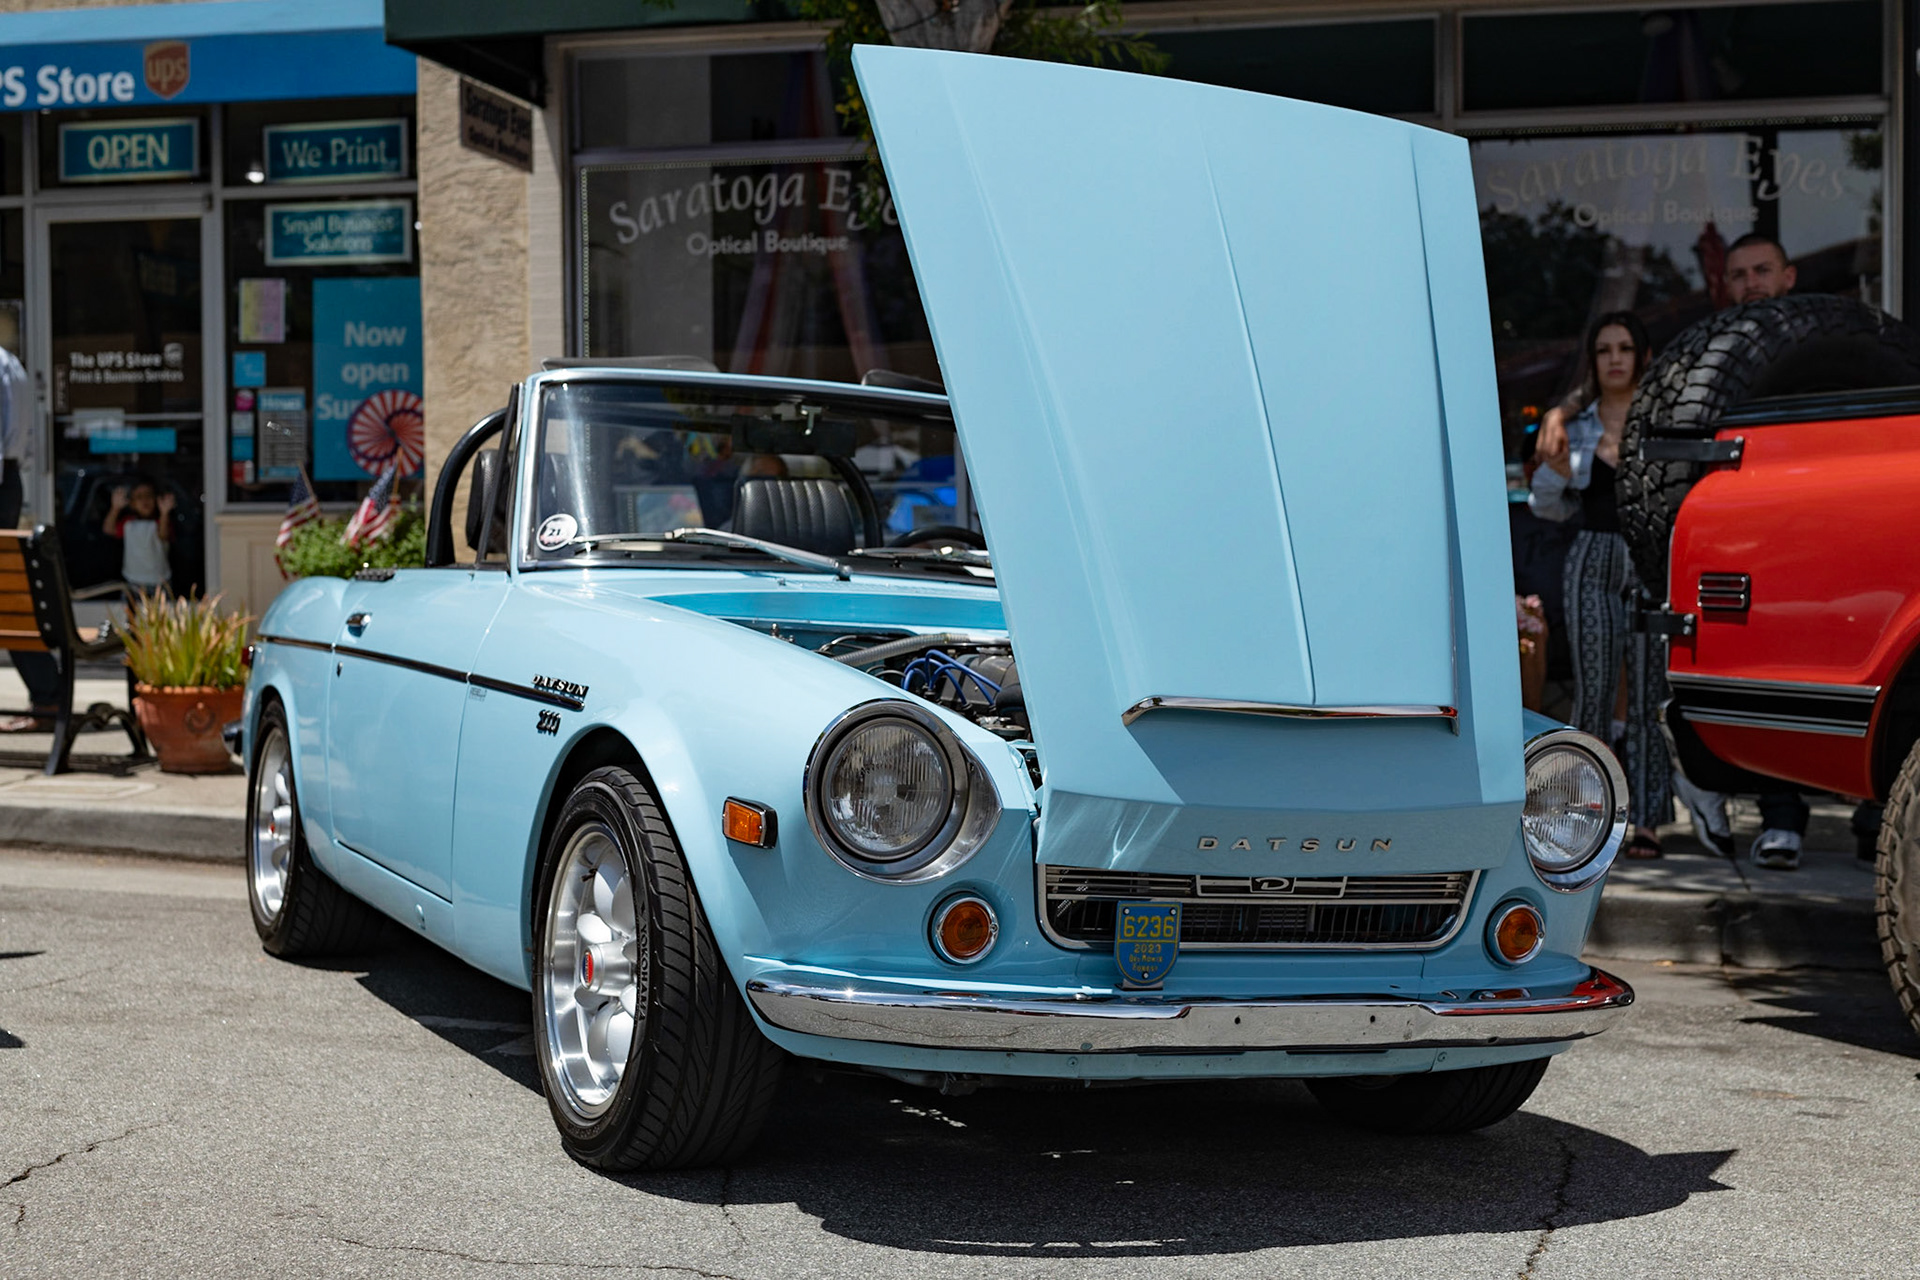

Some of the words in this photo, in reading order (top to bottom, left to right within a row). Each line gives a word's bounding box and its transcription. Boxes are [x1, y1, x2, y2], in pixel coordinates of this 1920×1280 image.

[0, 66, 27, 107] S
[36, 65, 136, 106] Store
[148, 58, 187, 91] ups
[88, 133, 169, 169] OPEN
[282, 138, 321, 168] We
[330, 136, 388, 167] Print
[1486, 137, 1708, 214] Saratoga
[1730, 133, 1846, 202] Eyes
[609, 172, 805, 244] Saratoga
[1573, 203, 1655, 228] Optical
[282, 215, 325, 235] Small
[686, 232, 758, 257] Optical
[764, 229, 849, 256] Boutique
[343, 321, 407, 348] Now
[341, 361, 409, 390] open
[531, 674, 588, 697] DATSUN
[1198, 836, 1392, 853] DATSUN
[1123, 916, 1175, 938] 6236
[1134, 943, 1162, 954] 2023
